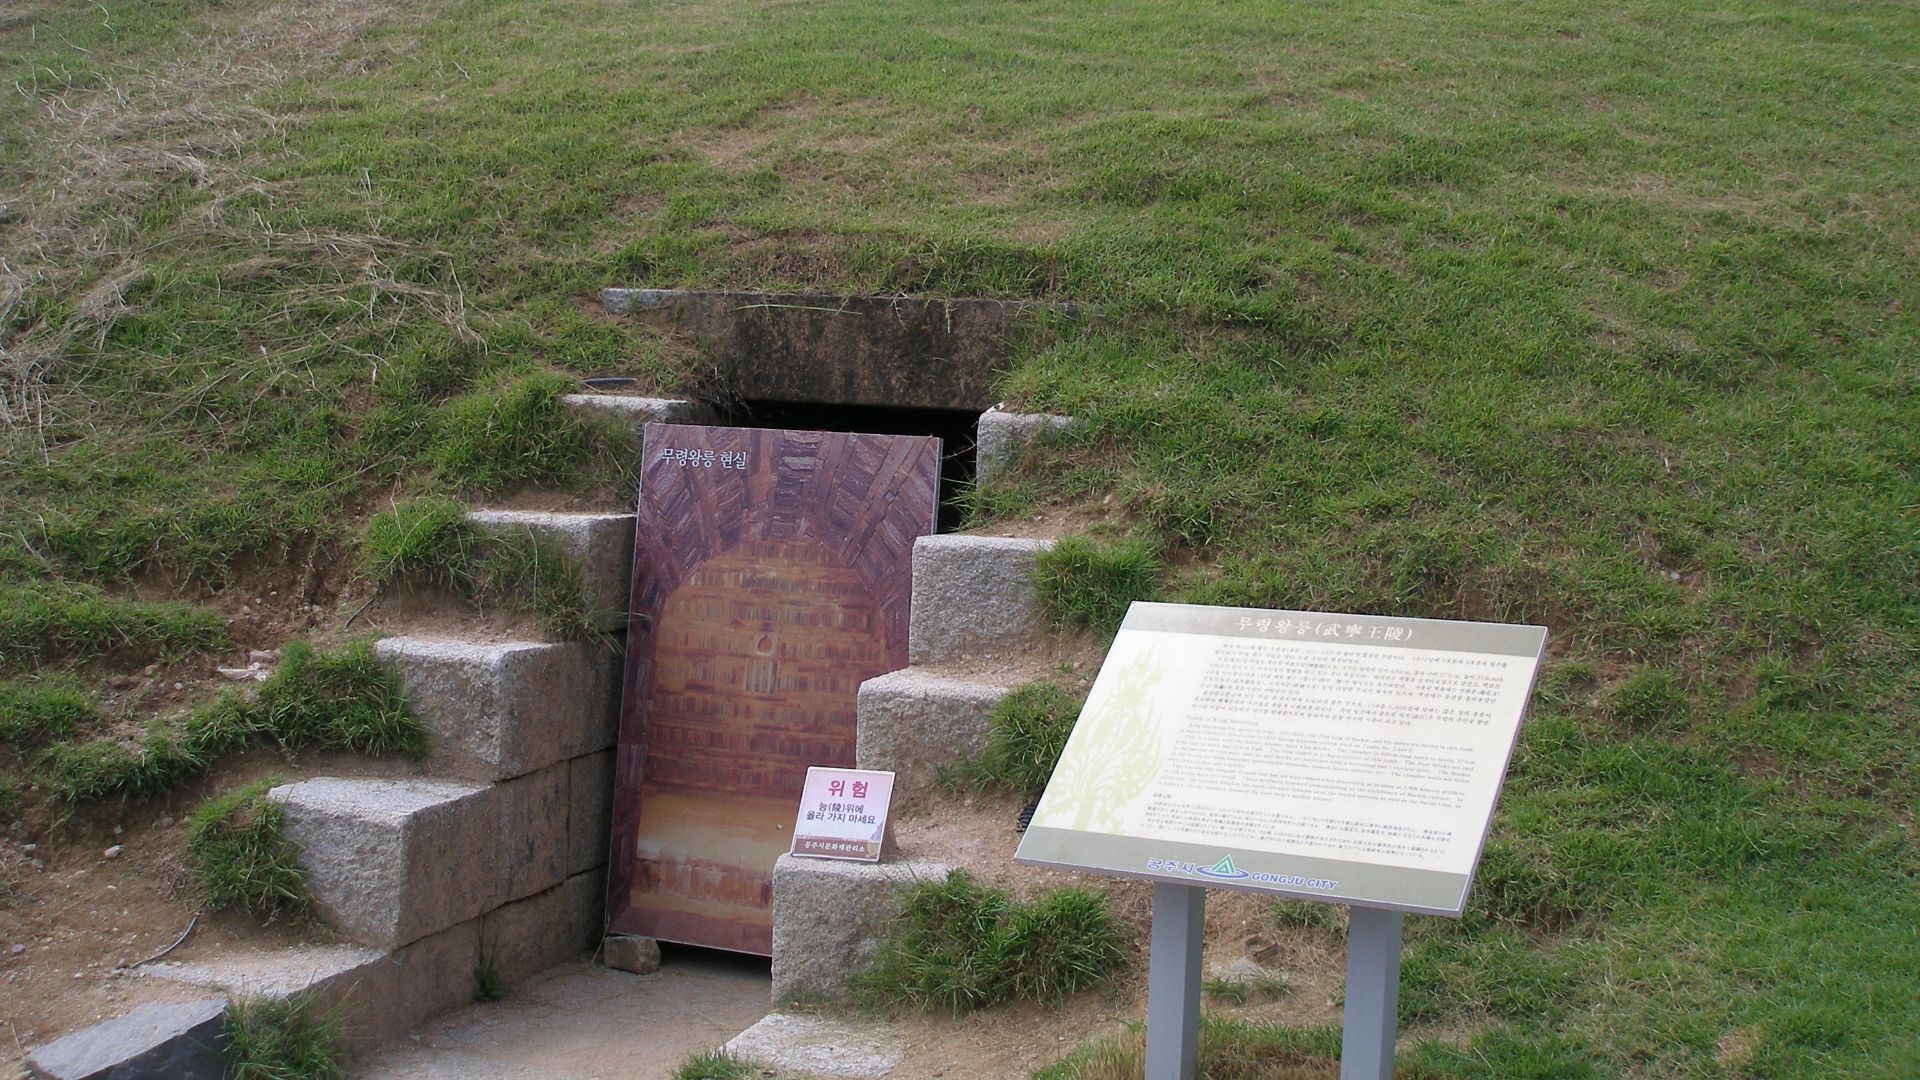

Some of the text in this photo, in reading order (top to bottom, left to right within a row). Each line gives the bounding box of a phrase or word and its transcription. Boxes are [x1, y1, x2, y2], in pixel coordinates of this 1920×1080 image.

[662, 448, 747, 470] 무령왕릉 현실
[807, 811, 875, 824] 올라 가지 마세요
[1147, 858, 1196, 874] 공주시
[1251, 871, 1337, 890] GONGJU CITY
